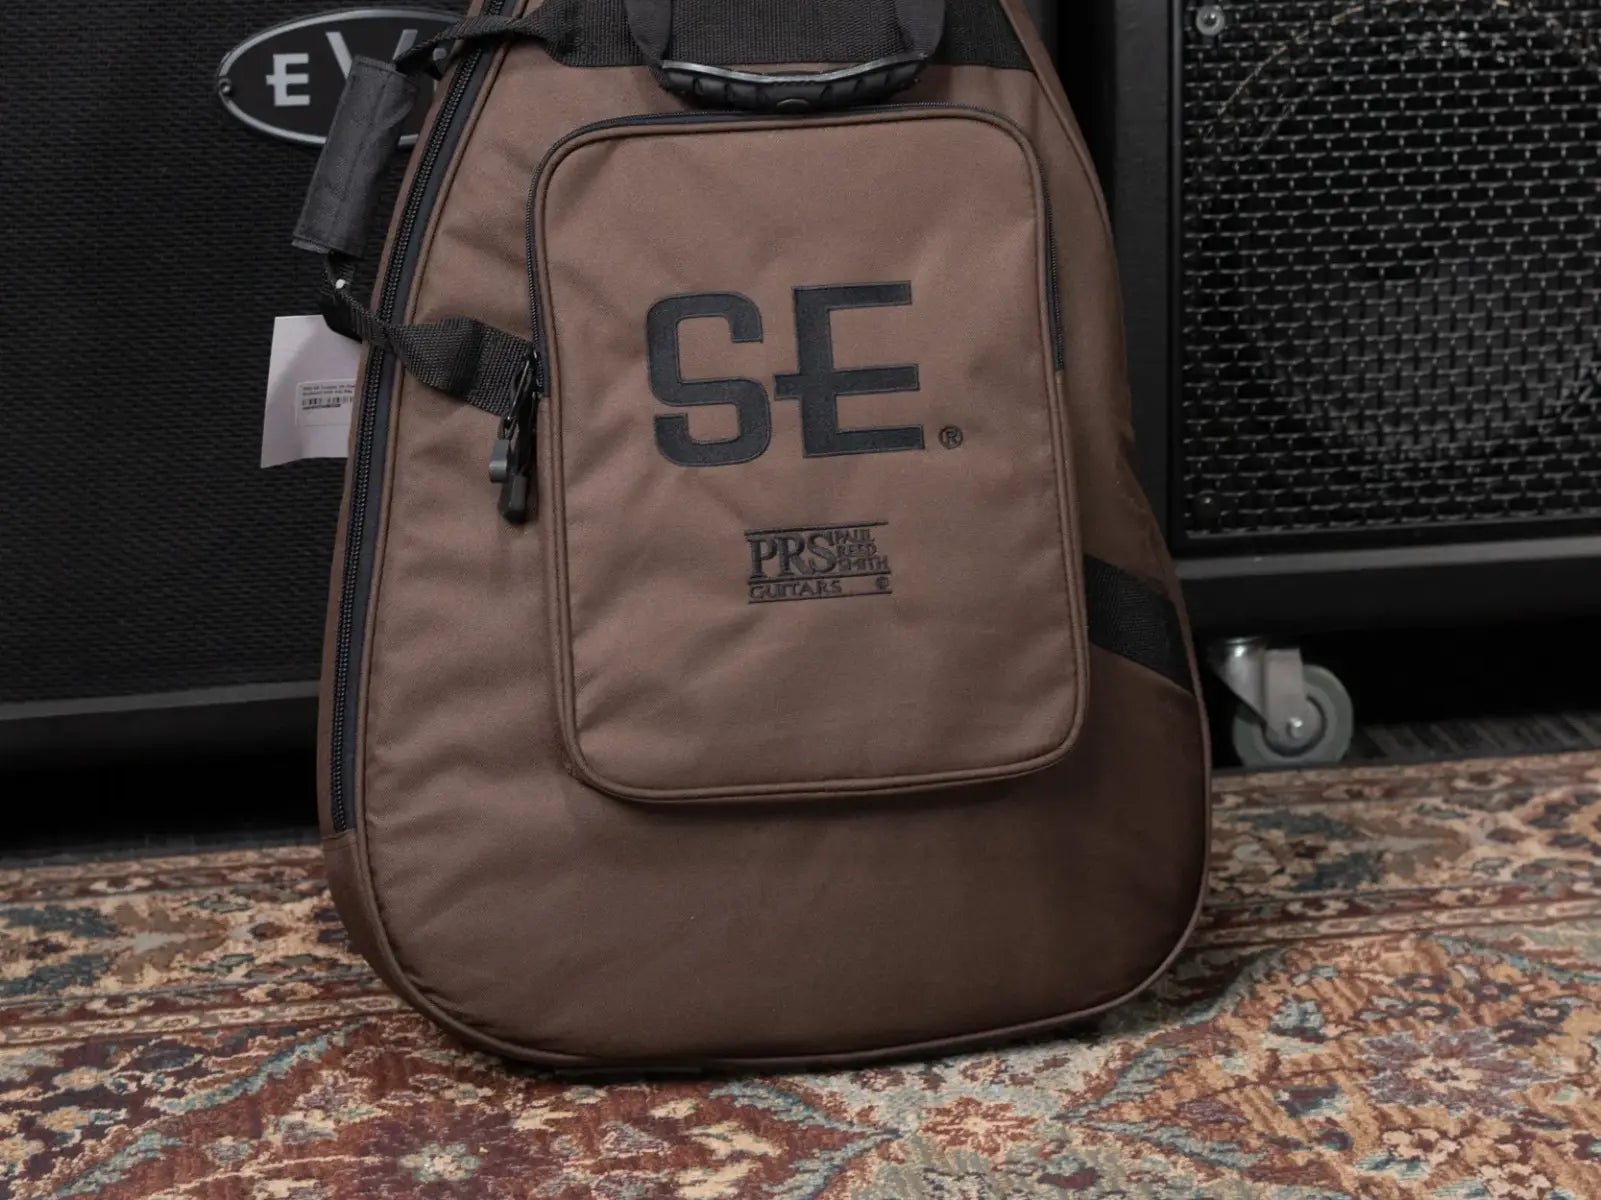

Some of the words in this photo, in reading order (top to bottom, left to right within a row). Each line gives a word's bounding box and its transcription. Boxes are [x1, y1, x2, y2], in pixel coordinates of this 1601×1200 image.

[646, 280, 925, 467] SE
[746, 530, 837, 580] PRS
[749, 580, 842, 599] GUITARS
